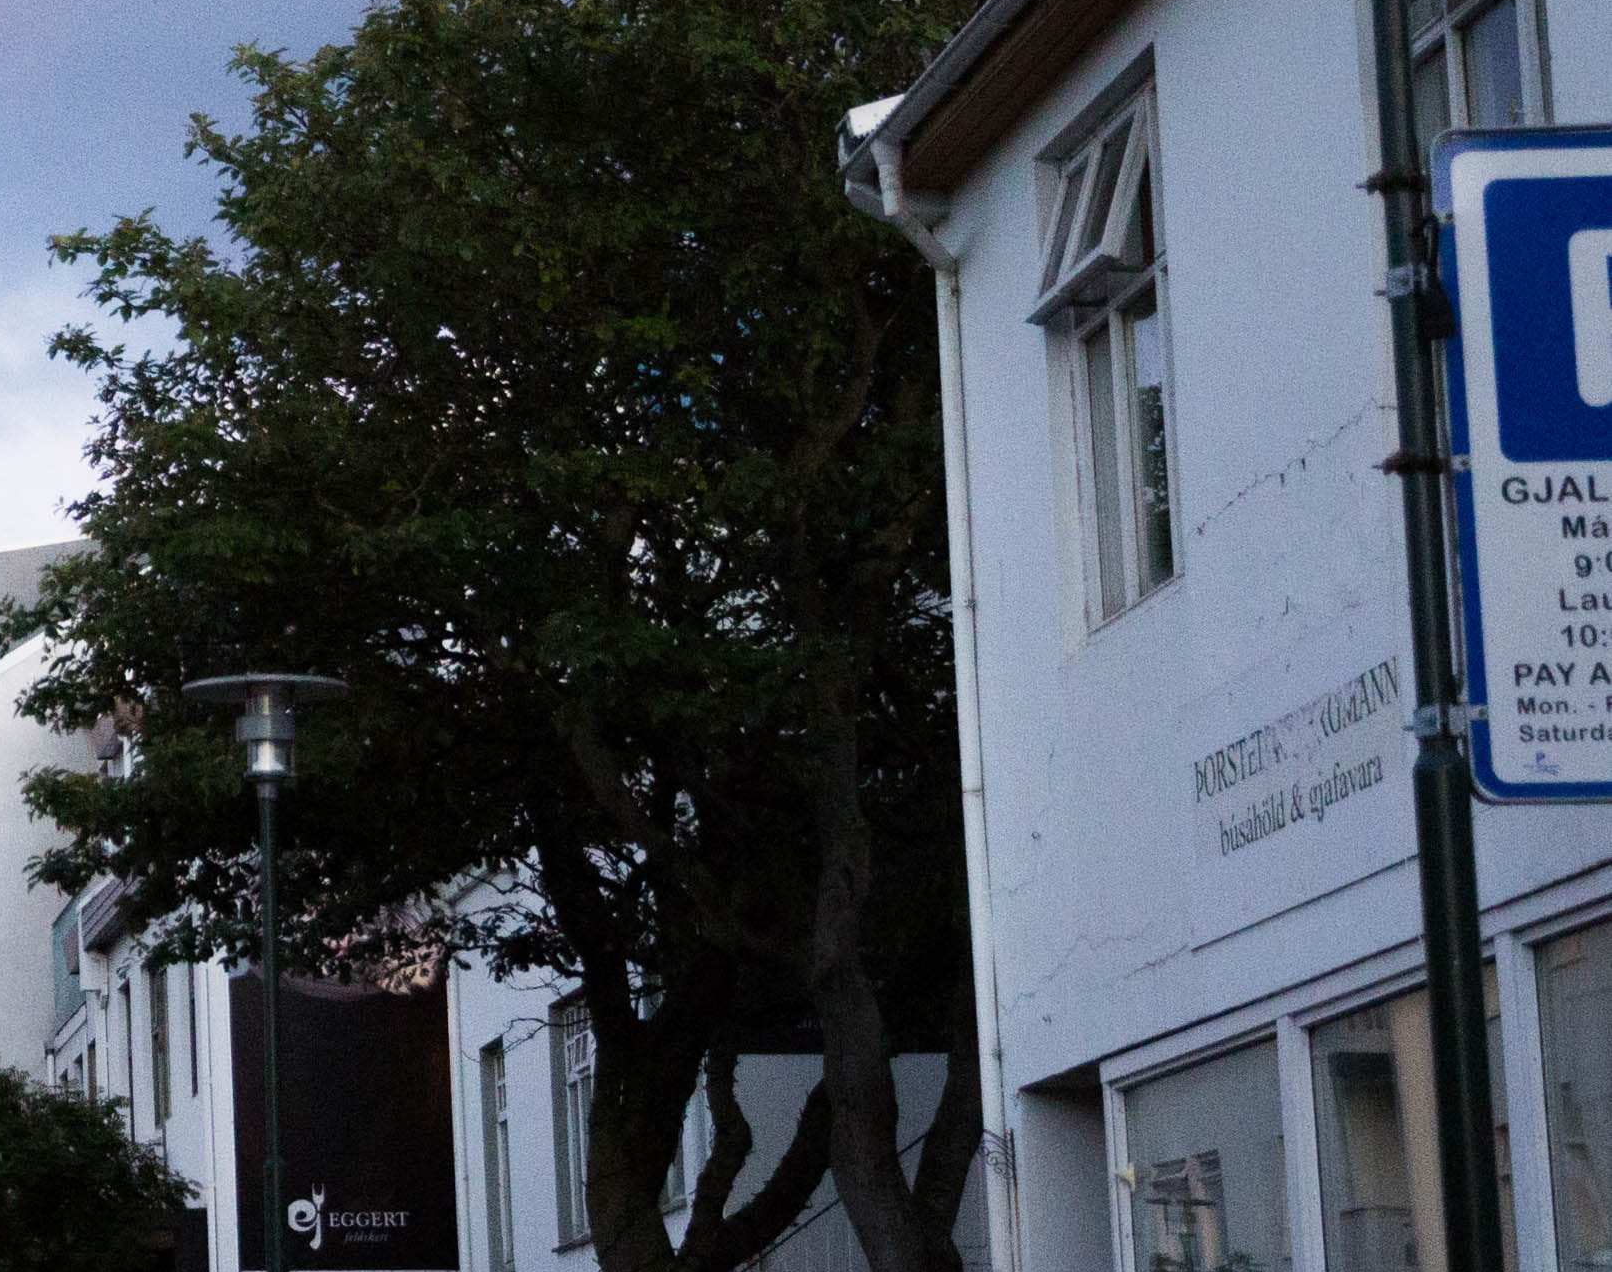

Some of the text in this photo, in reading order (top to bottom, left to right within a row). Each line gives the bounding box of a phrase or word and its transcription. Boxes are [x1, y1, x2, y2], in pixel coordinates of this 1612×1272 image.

[1501, 475, 1609, 505] GJAL
[1561, 514, 1609, 539] Má
[1514, 661, 1576, 686] PAY
[1517, 696, 1578, 715] Mon.
[1219, 755, 1384, 857] búsáhöld & gjafavara
[328, 1211, 410, 1228] EGGERT
